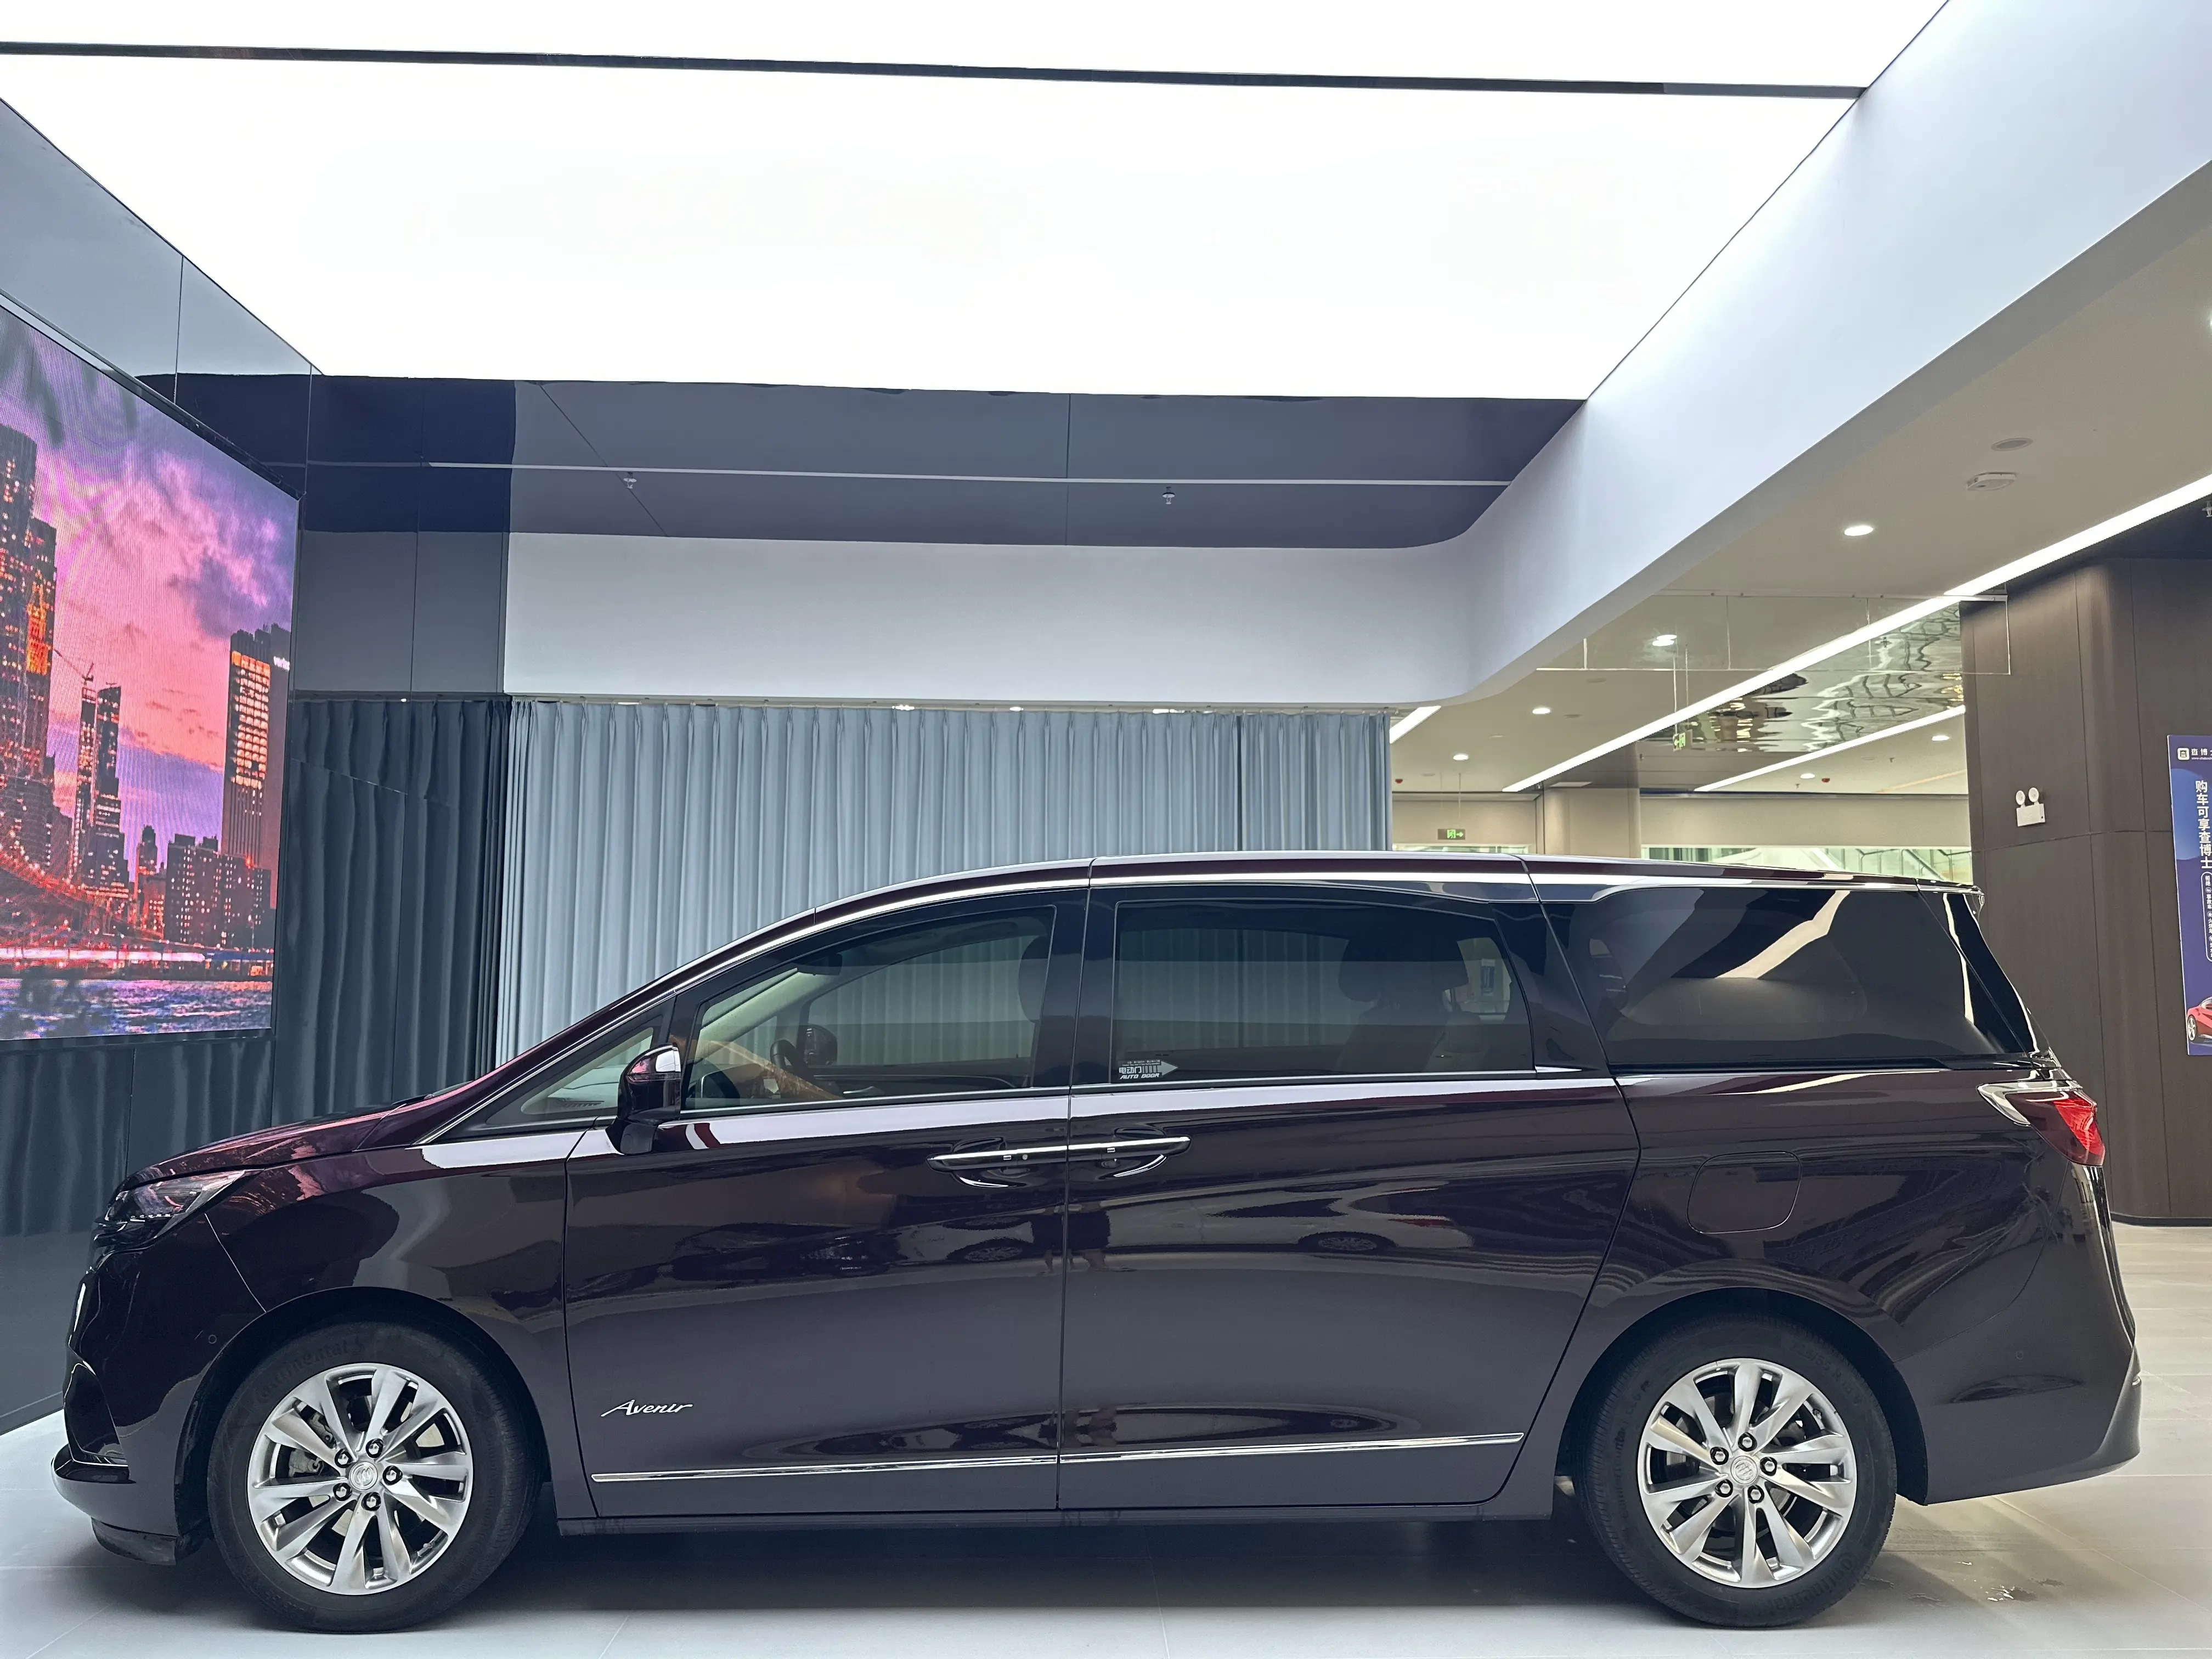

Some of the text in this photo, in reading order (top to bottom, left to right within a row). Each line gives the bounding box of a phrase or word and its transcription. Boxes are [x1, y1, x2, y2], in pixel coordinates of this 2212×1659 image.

[2196, 780, 2212, 869] 购车可享查博士
[601, 1400, 693, 1417] Avenir
